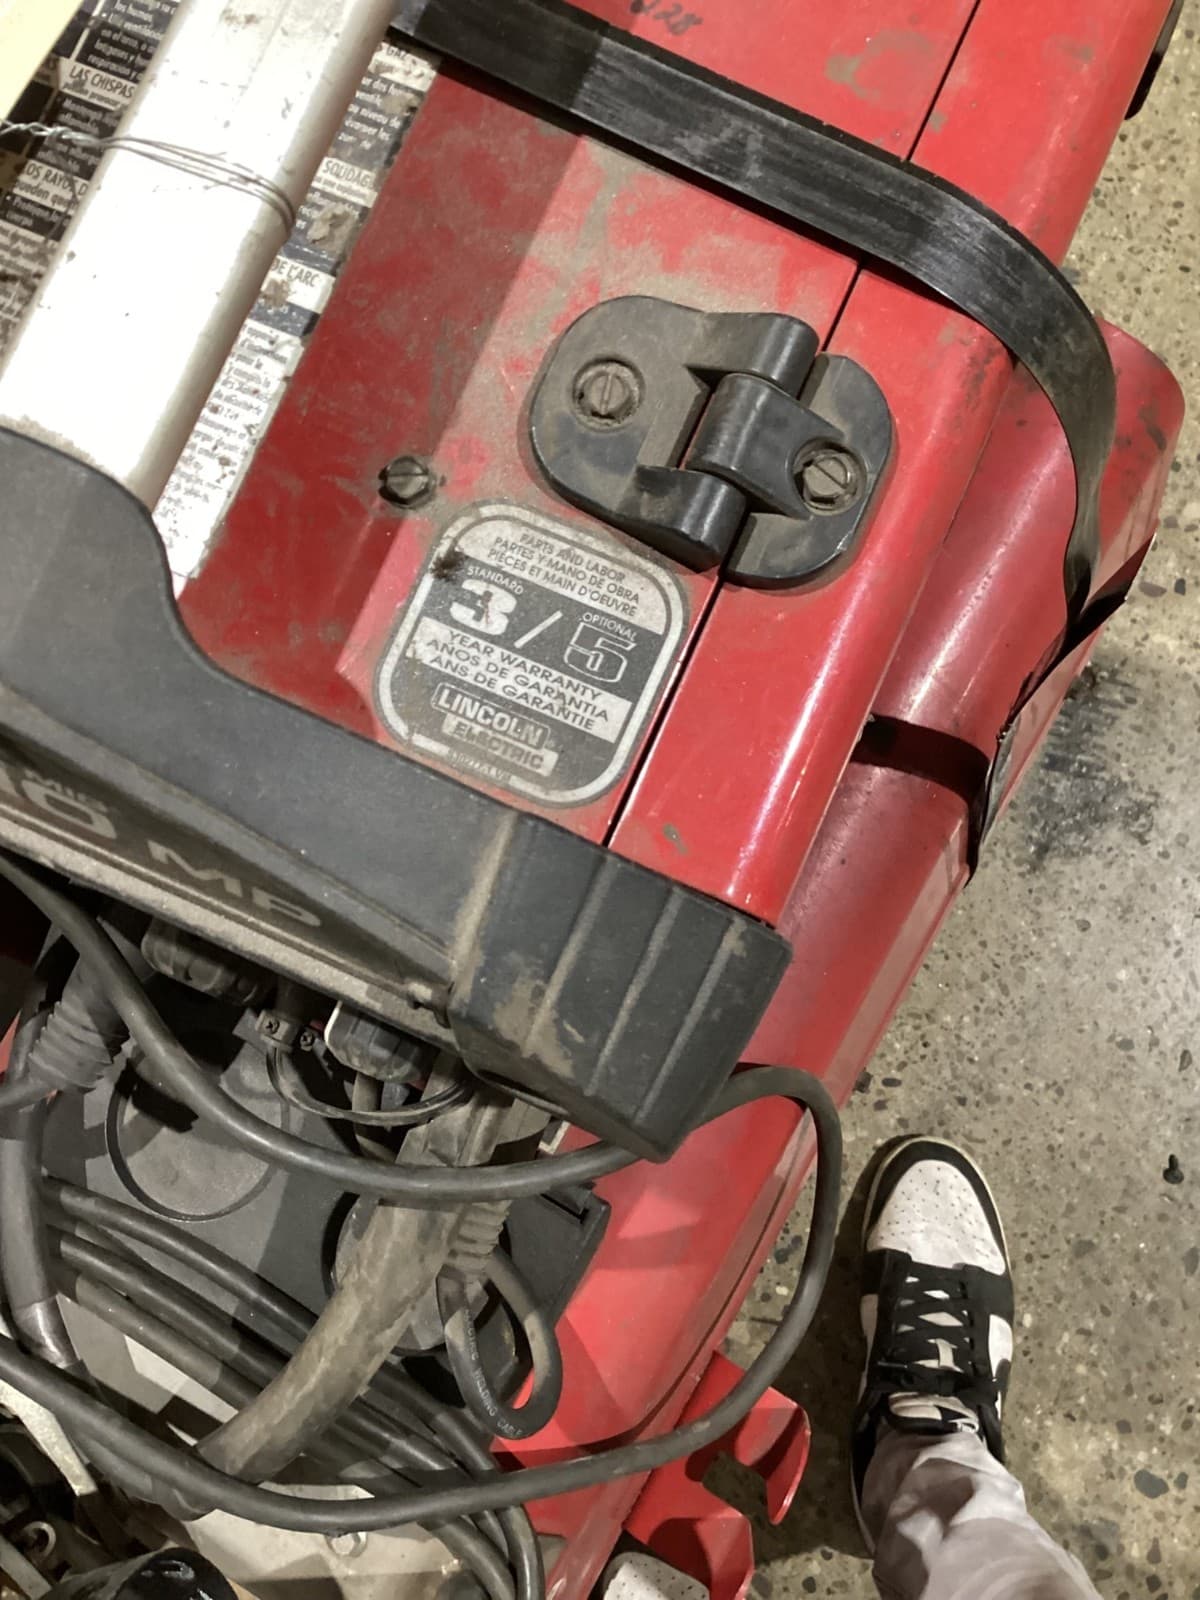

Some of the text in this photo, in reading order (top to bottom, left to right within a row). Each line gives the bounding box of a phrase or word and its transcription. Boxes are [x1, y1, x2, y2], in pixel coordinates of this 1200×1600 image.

[69, 64, 134, 99] LAS CHISPAS
[466, 562, 525, 595] STANDARD
[493, 536, 642, 605] PARTES Y MANO DE OBRA
[519, 532, 626, 584] PARTS AND LABOR
[528, 564, 543, 579] ET
[541, 570, 578, 593] MAIN
[576, 584, 638, 618] D'OEUVRE
[449, 578, 518, 637] 3
[563, 621, 637, 684] 5
[580, 608, 638, 641] OPTIONAL
[429, 653, 596, 731] ANS DE GARANTIE
[446, 630, 603, 703] YEAR WARRANTY
[484, 660, 509, 679] DE
[436, 687, 545, 746] LINCOLN
[451, 720, 545, 771] ELECTRIC
